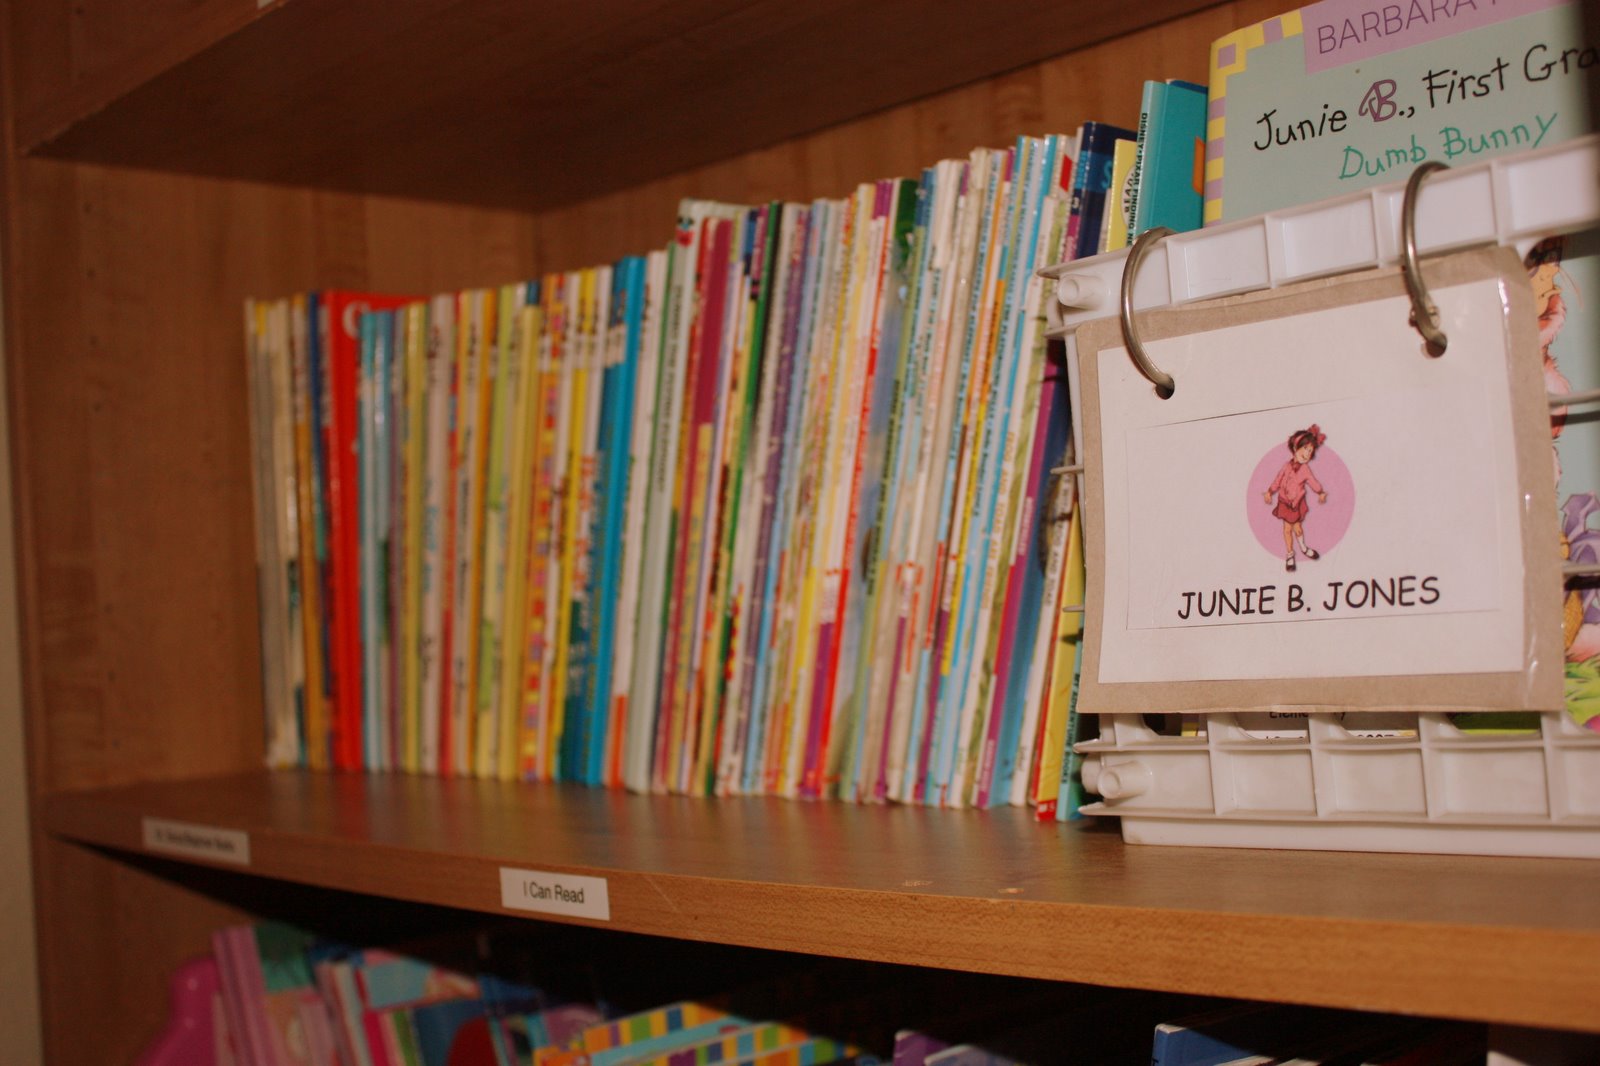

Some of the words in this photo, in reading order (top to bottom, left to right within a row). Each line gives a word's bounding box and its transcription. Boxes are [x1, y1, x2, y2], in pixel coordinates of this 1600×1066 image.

[1317, 0, 1478, 55] BARBARA
[1253, 108, 1348, 151] Junie
[1422, 57, 1510, 108] First
[1338, 135, 1427, 180] Dumb
[1439, 113, 1559, 158] Bunny
[1128, 188, 1140, 229] FINDING
[1126, 233, 1134, 246] NE
[1178, 585, 1276, 619] JUNIE
[1287, 584, 1311, 612] B.
[1323, 576, 1440, 611] JONES
[1061, 751, 1071, 784] BOOKS
[523, 880, 527, 896] I
[529, 881, 552, 900] Can
[554, 884, 585, 904] Read
